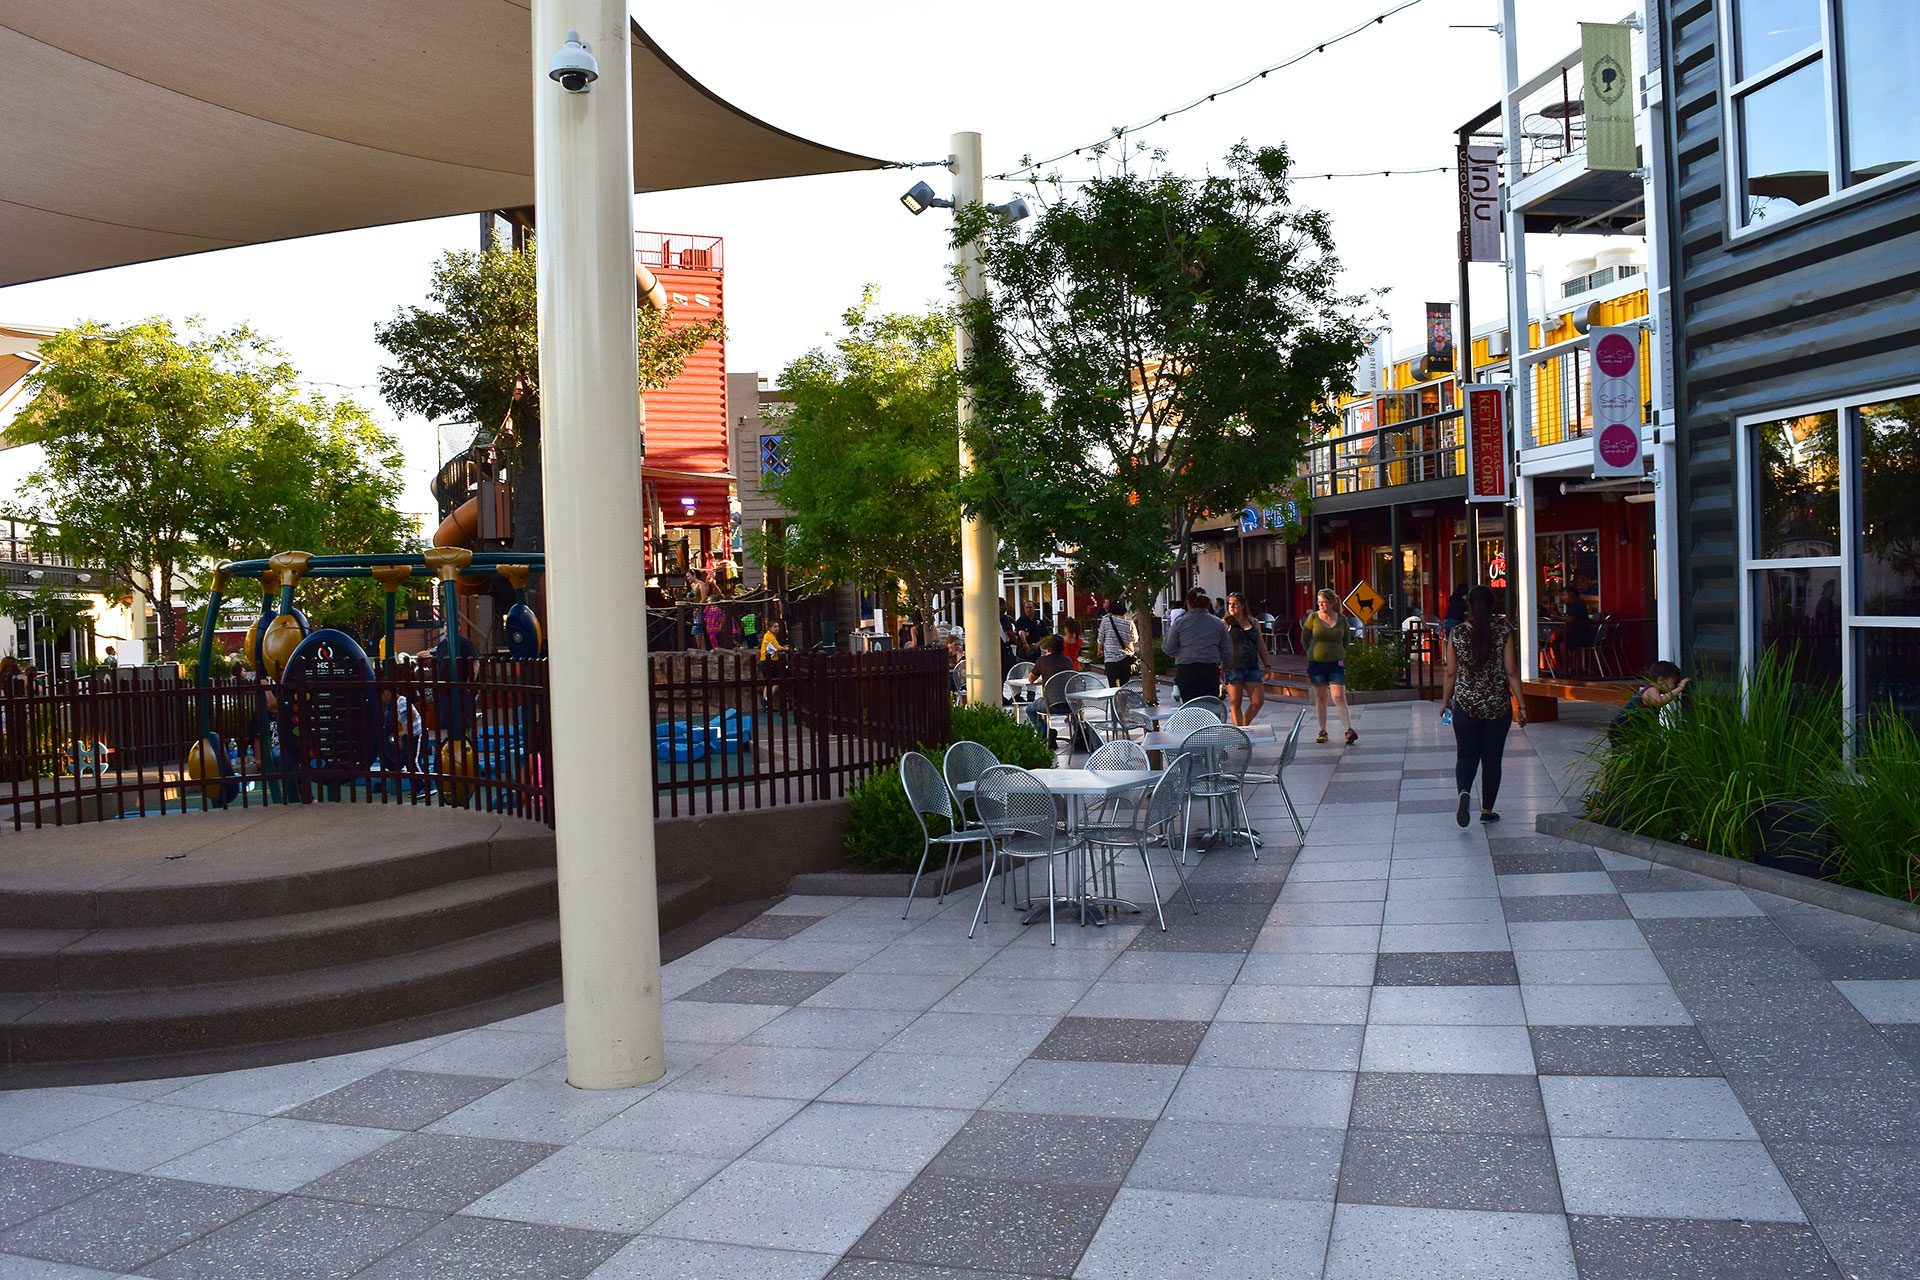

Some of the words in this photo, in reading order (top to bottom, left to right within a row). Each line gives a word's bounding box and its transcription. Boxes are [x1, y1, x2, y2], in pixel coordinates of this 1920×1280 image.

[1459, 151, 1469, 256] CHOCOLATES
[1597, 349, 1615, 360] Sweet
[1615, 350, 1633, 363] Spot
[1599, 394, 1617, 404] Sweet
[1617, 394, 1634, 408] Spot
[1480, 394, 1492, 451] KETTLE
[1492, 419, 1500, 436] LAS
[1493, 439, 1502, 471] VEGAS
[1601, 440, 1618, 450] Sweet
[1618, 440, 1635, 453] Spot
[1482, 456, 1494, 494] CORN
